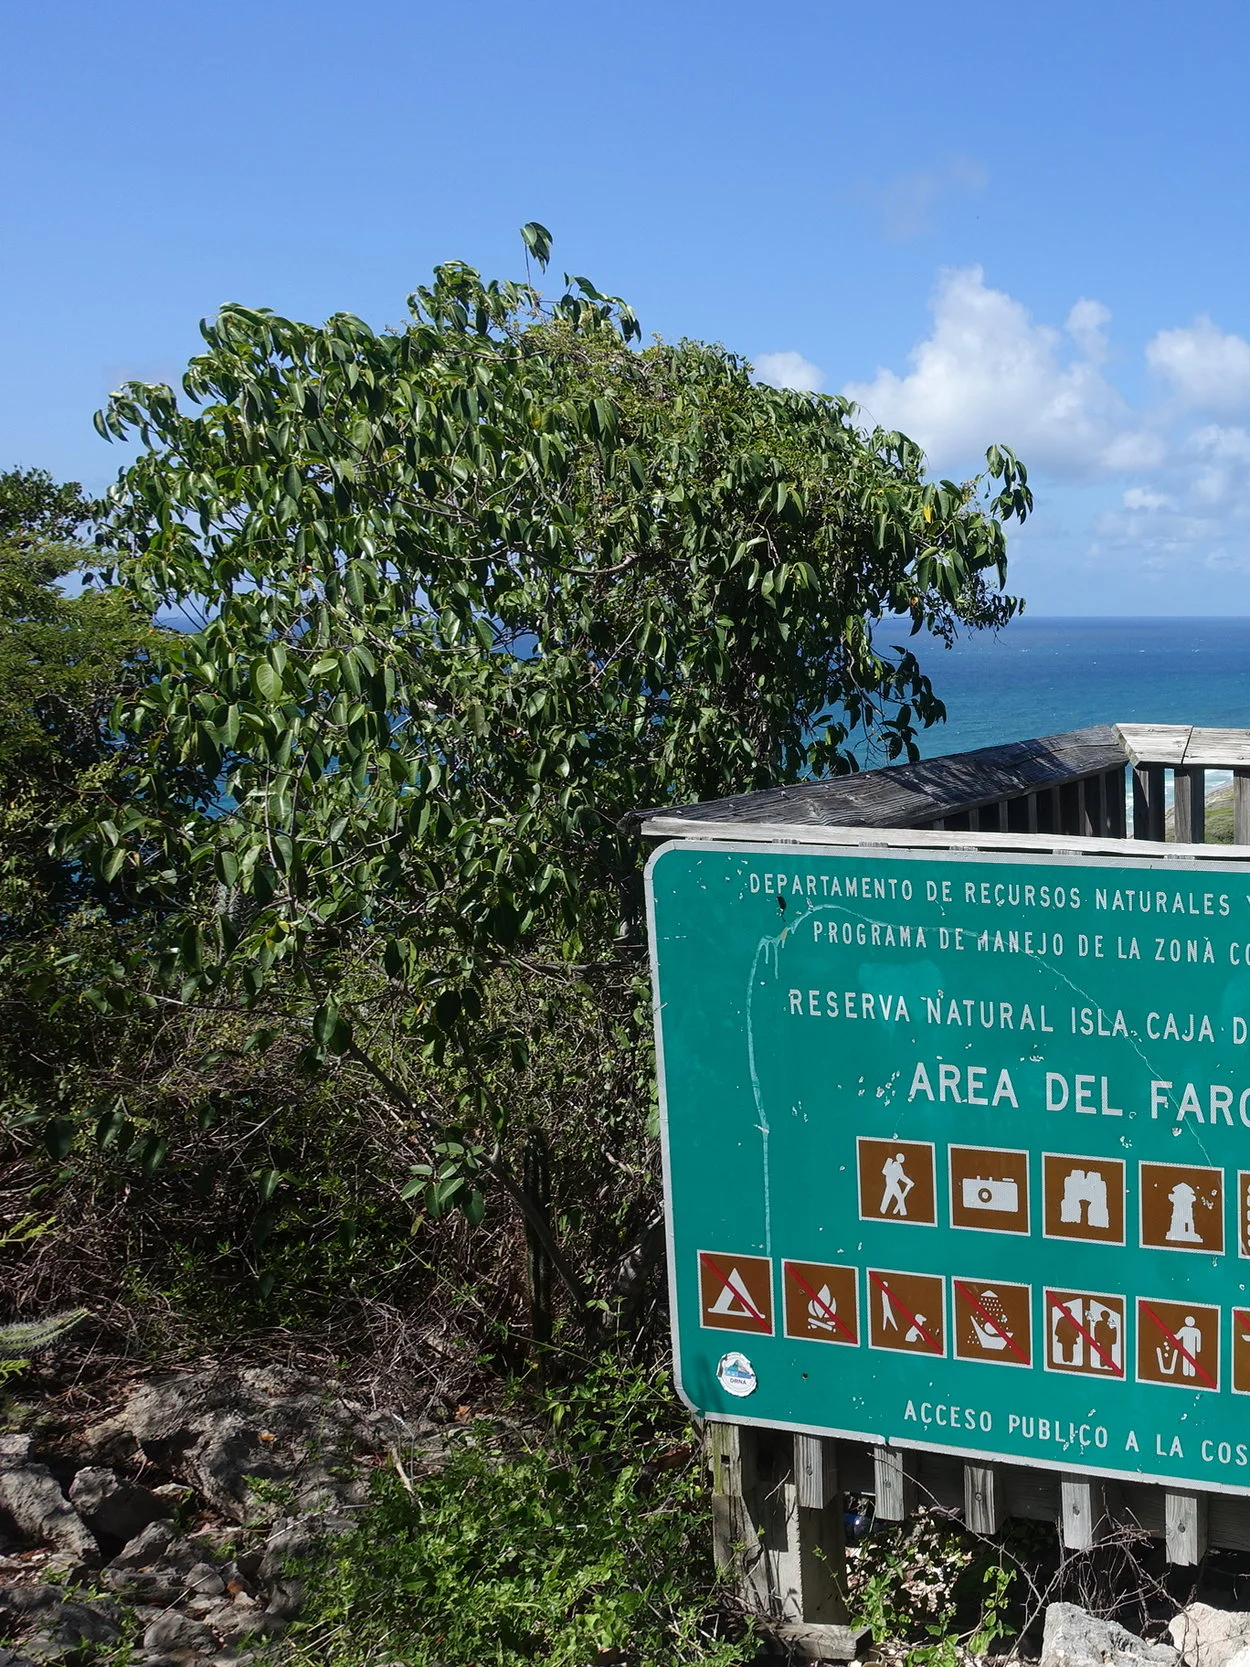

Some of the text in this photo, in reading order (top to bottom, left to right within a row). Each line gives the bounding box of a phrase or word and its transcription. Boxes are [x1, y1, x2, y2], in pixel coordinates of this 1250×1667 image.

[750, 874, 912, 900] DEPARTAMENTO
[927, 881, 952, 901] DE
[966, 883, 1080, 908] RECURSOS
[1096, 889, 1229, 915] NATURALES
[814, 922, 926, 947] PROGRAMA
[940, 928, 963, 949] DE
[978, 930, 1062, 955] MANEJO
[1079, 935, 1103, 957] DE
[1118, 937, 1140, 959] LA
[1155, 939, 1214, 963] ZONA
[789, 990, 909, 1021] RESERVA
[927, 998, 1053, 1031] NATURAL
[1072, 1008, 1128, 1036] ISLA
[1147, 1012, 1214, 1042] CAJA
[908, 1063, 1018, 1107] AREA
[1046, 1072, 1122, 1116] DEL
[905, 1400, 991, 1431] ACCESO
[1009, 1415, 1107, 1447] PUBLICO
[1126, 1431, 1139, 1451] A
[1157, 1435, 1183, 1457] LA
